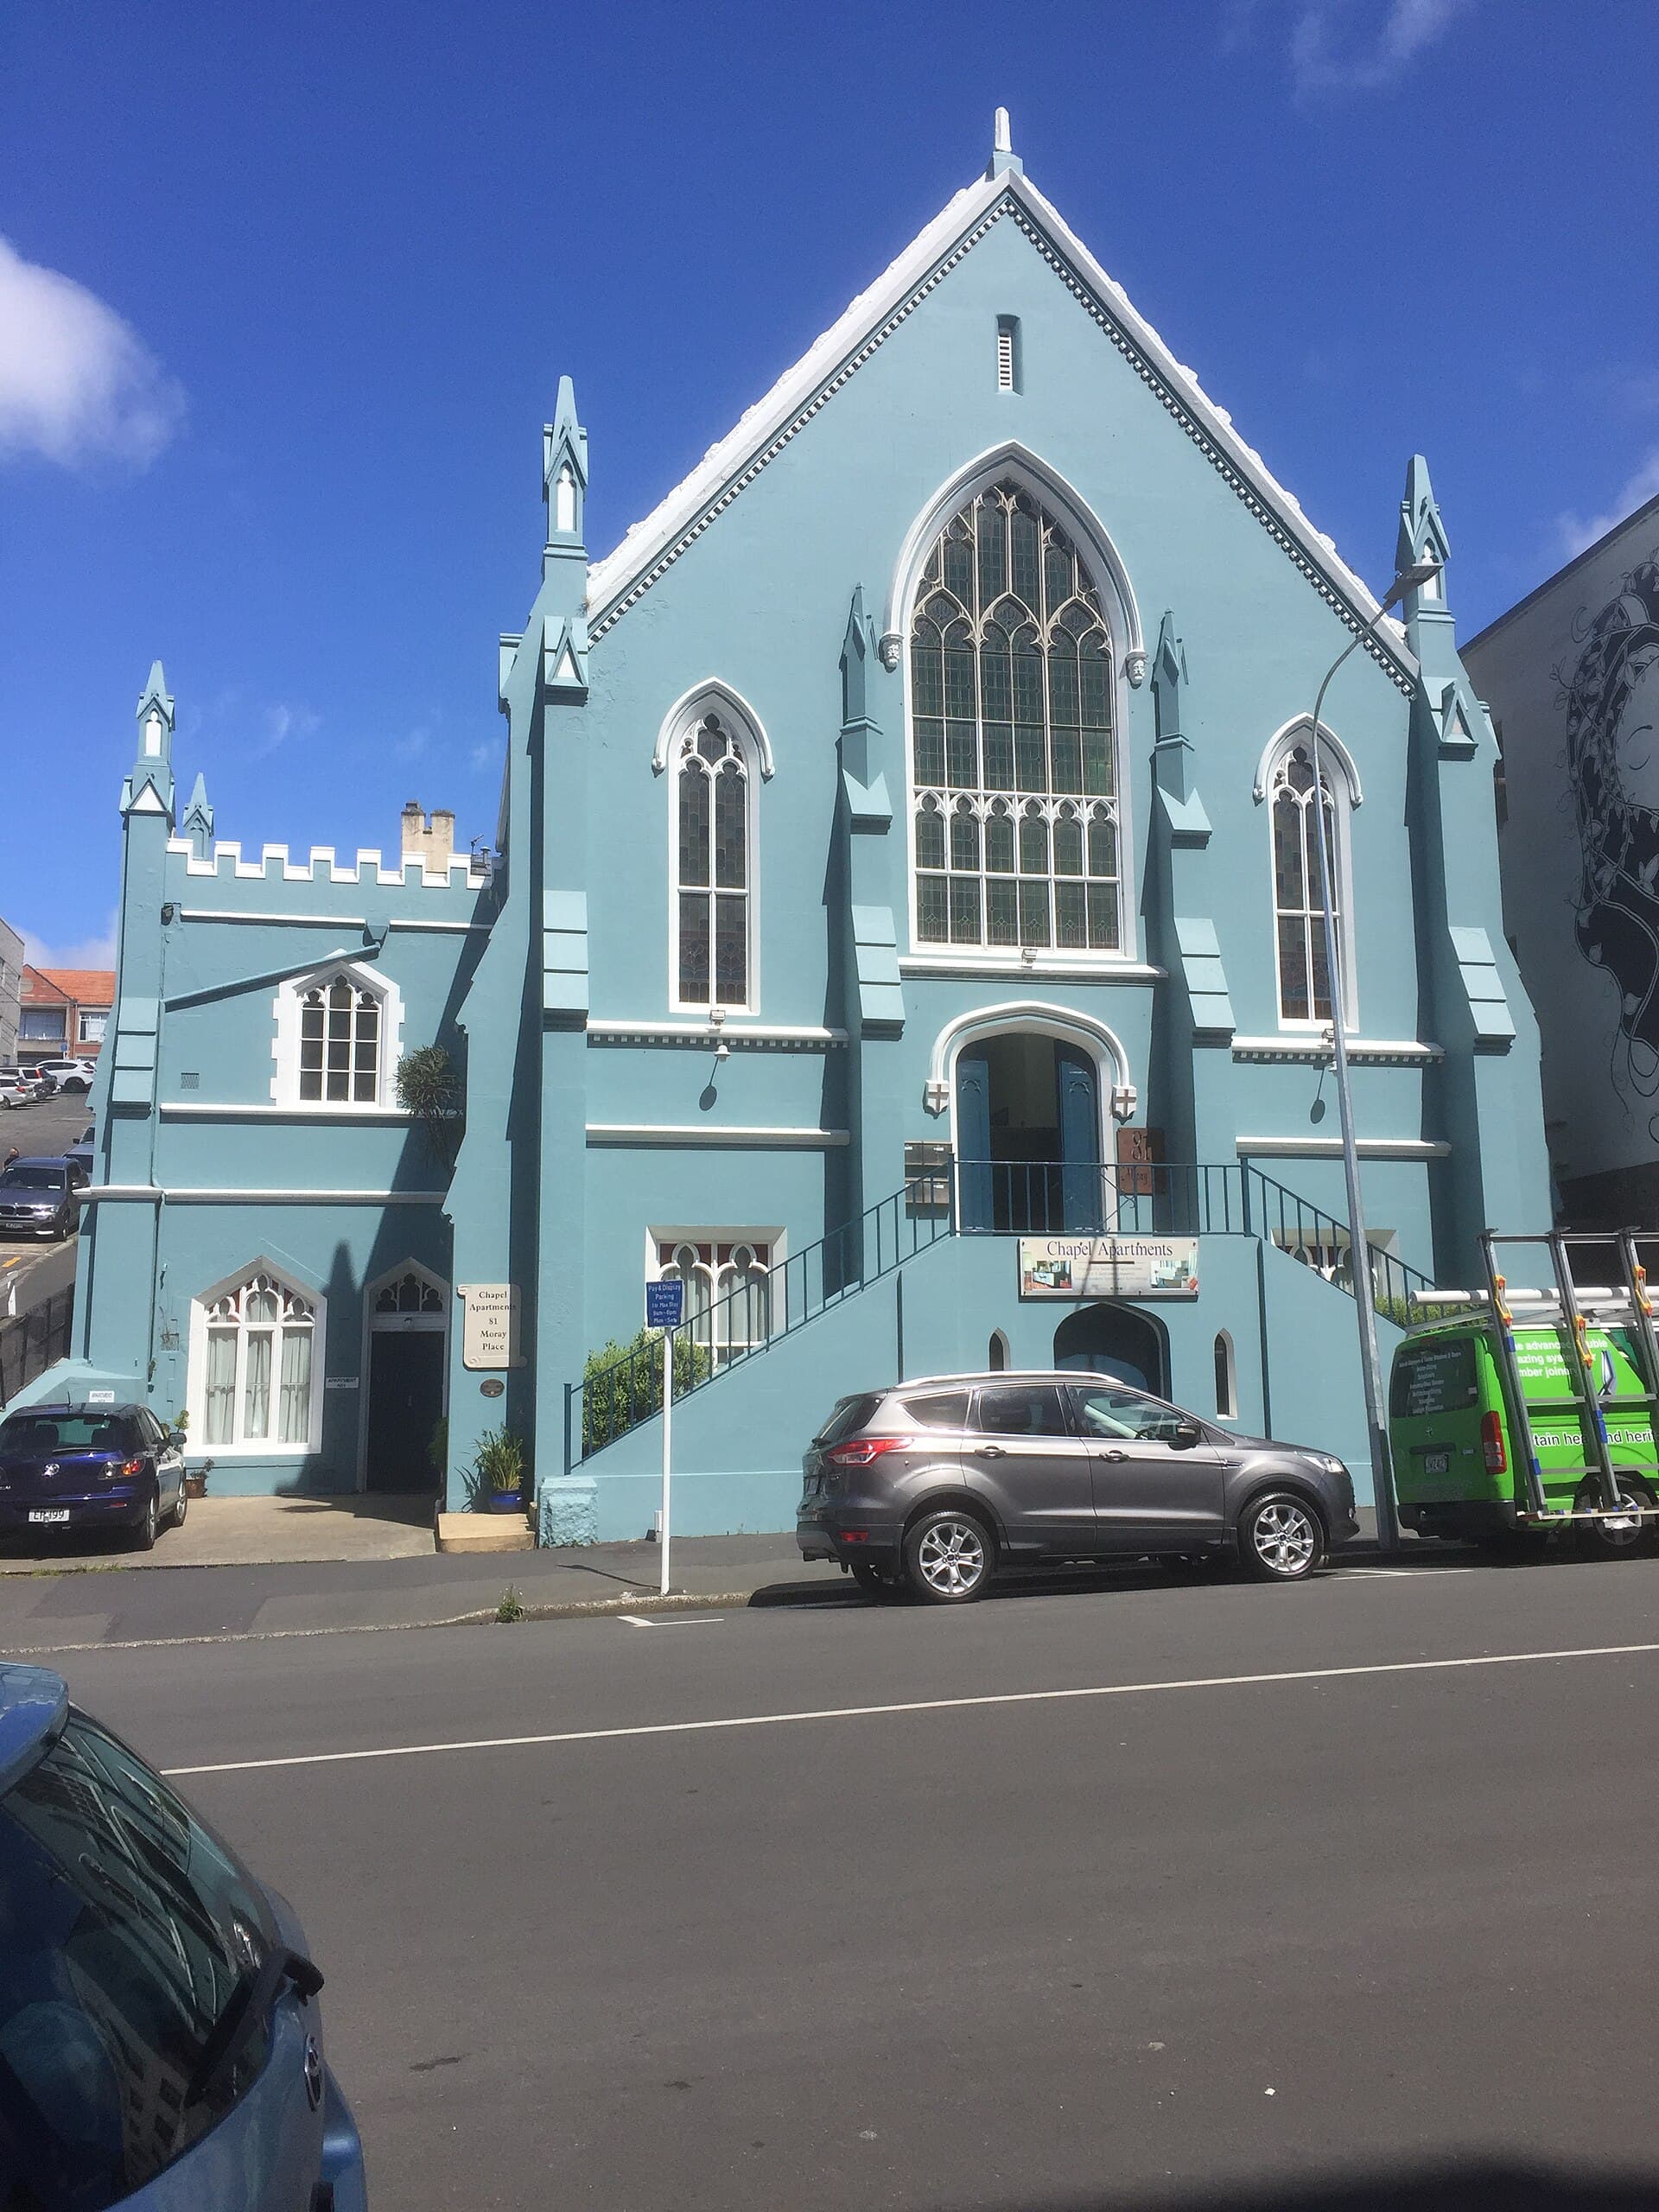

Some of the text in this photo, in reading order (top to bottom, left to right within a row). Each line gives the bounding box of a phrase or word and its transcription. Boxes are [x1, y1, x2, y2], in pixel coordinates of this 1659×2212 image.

[1047, 1241, 1173, 1259] Chapel Apartments
[479, 1291, 507, 1300] Chapel
[469, 1303, 516, 1312] Apartments
[1517, 1354, 1544, 1365] azing
[1519, 1366, 1543, 1376] mber
[1607, 1430, 1623, 1443] nd
